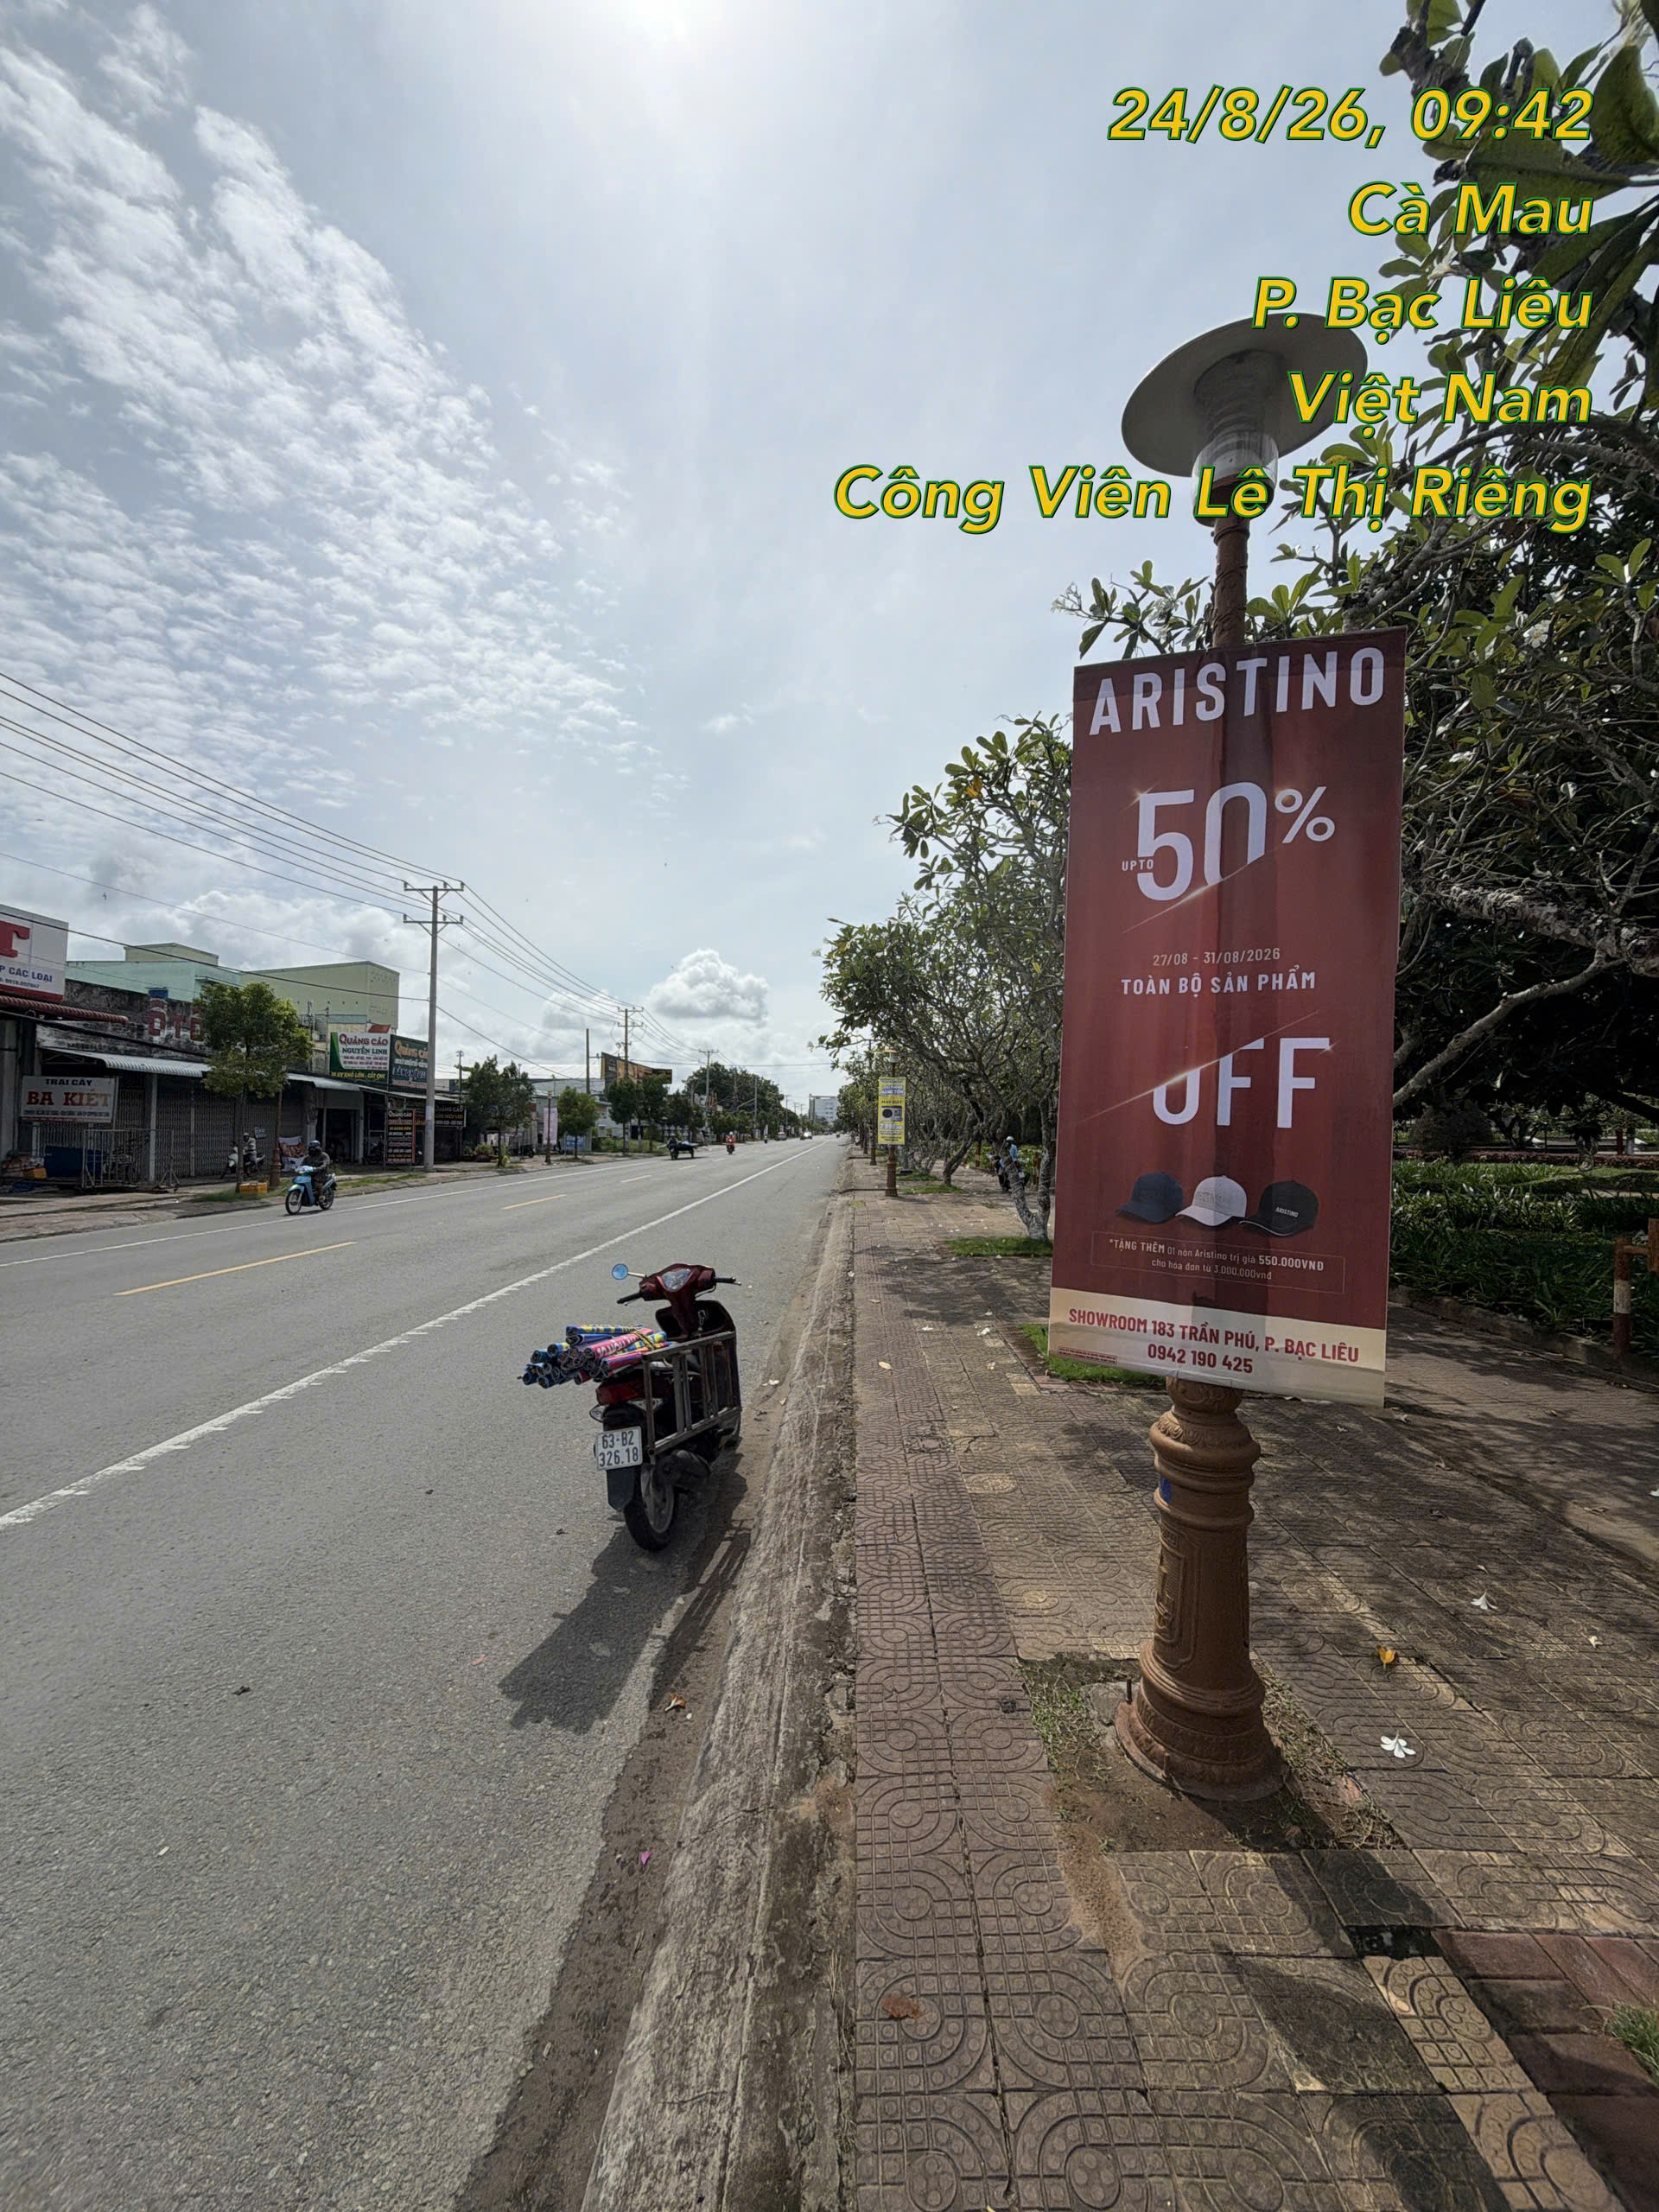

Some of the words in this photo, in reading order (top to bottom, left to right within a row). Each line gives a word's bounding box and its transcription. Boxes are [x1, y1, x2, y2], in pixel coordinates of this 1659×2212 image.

[1089, 647, 1384, 735] ARISTINO
[1153, 953, 1188, 966] 27/08
[1203, 948, 1281, 963] 31/08/2026
[1122, 975, 1170, 995] TOÀN
[1179, 972, 1202, 998] BỘ
[1211, 972, 1248, 994] SẢN
[1257, 964, 1315, 991] PHẨM
[27, 1091, 54, 1106] BA
[1140, 1241, 1165, 1254] THÊM
[1166, 1246, 1176, 1255] 01
[1194, 1249, 1227, 1261] Aristino
[1230, 1254, 1240, 1264] trị
[1258, 1255, 1325, 1271] 550.000VNĐ
[1151, 1258, 1166, 1268] cho
[1213, 1266, 1273, 1280] 3.000.000vnđ
[1069, 1308, 1147, 1334] SHOWROOM
[1151, 1320, 1175, 1338] 183
[1179, 1320, 1219, 1344] TRẦN
[1224, 1331, 1259, 1352] PHÚ,
[1264, 1336, 1280, 1353] P.
[1284, 1338, 1317, 1361] BẠC
[1321, 1342, 1359, 1363] LIÊU
[1147, 1343, 1186, 1363] 0942
[1191, 1350, 1217, 1368] 190
[1221, 1355, 1253, 1374] 425
[601, 1430, 634, 1449] 63-B2
[598, 1446, 639, 1467] 326.18
